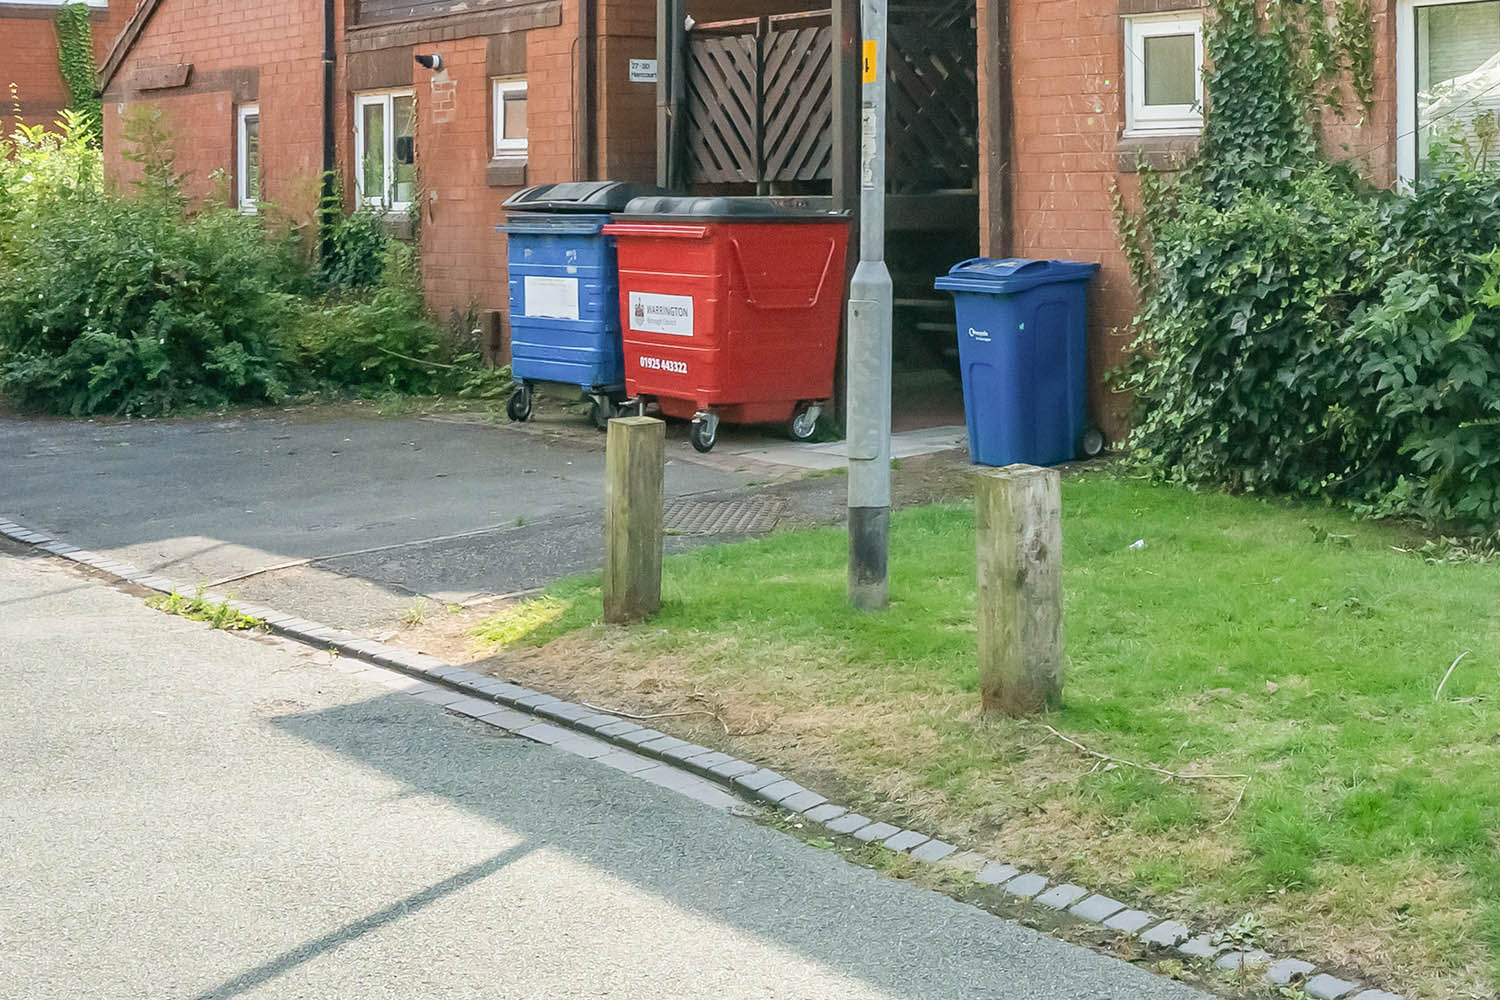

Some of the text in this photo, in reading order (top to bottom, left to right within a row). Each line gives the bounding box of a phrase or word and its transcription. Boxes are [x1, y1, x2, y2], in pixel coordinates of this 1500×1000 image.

[646, 305, 689, 318] WARRINGTON
[640, 356, 688, 374] 01925 443322
